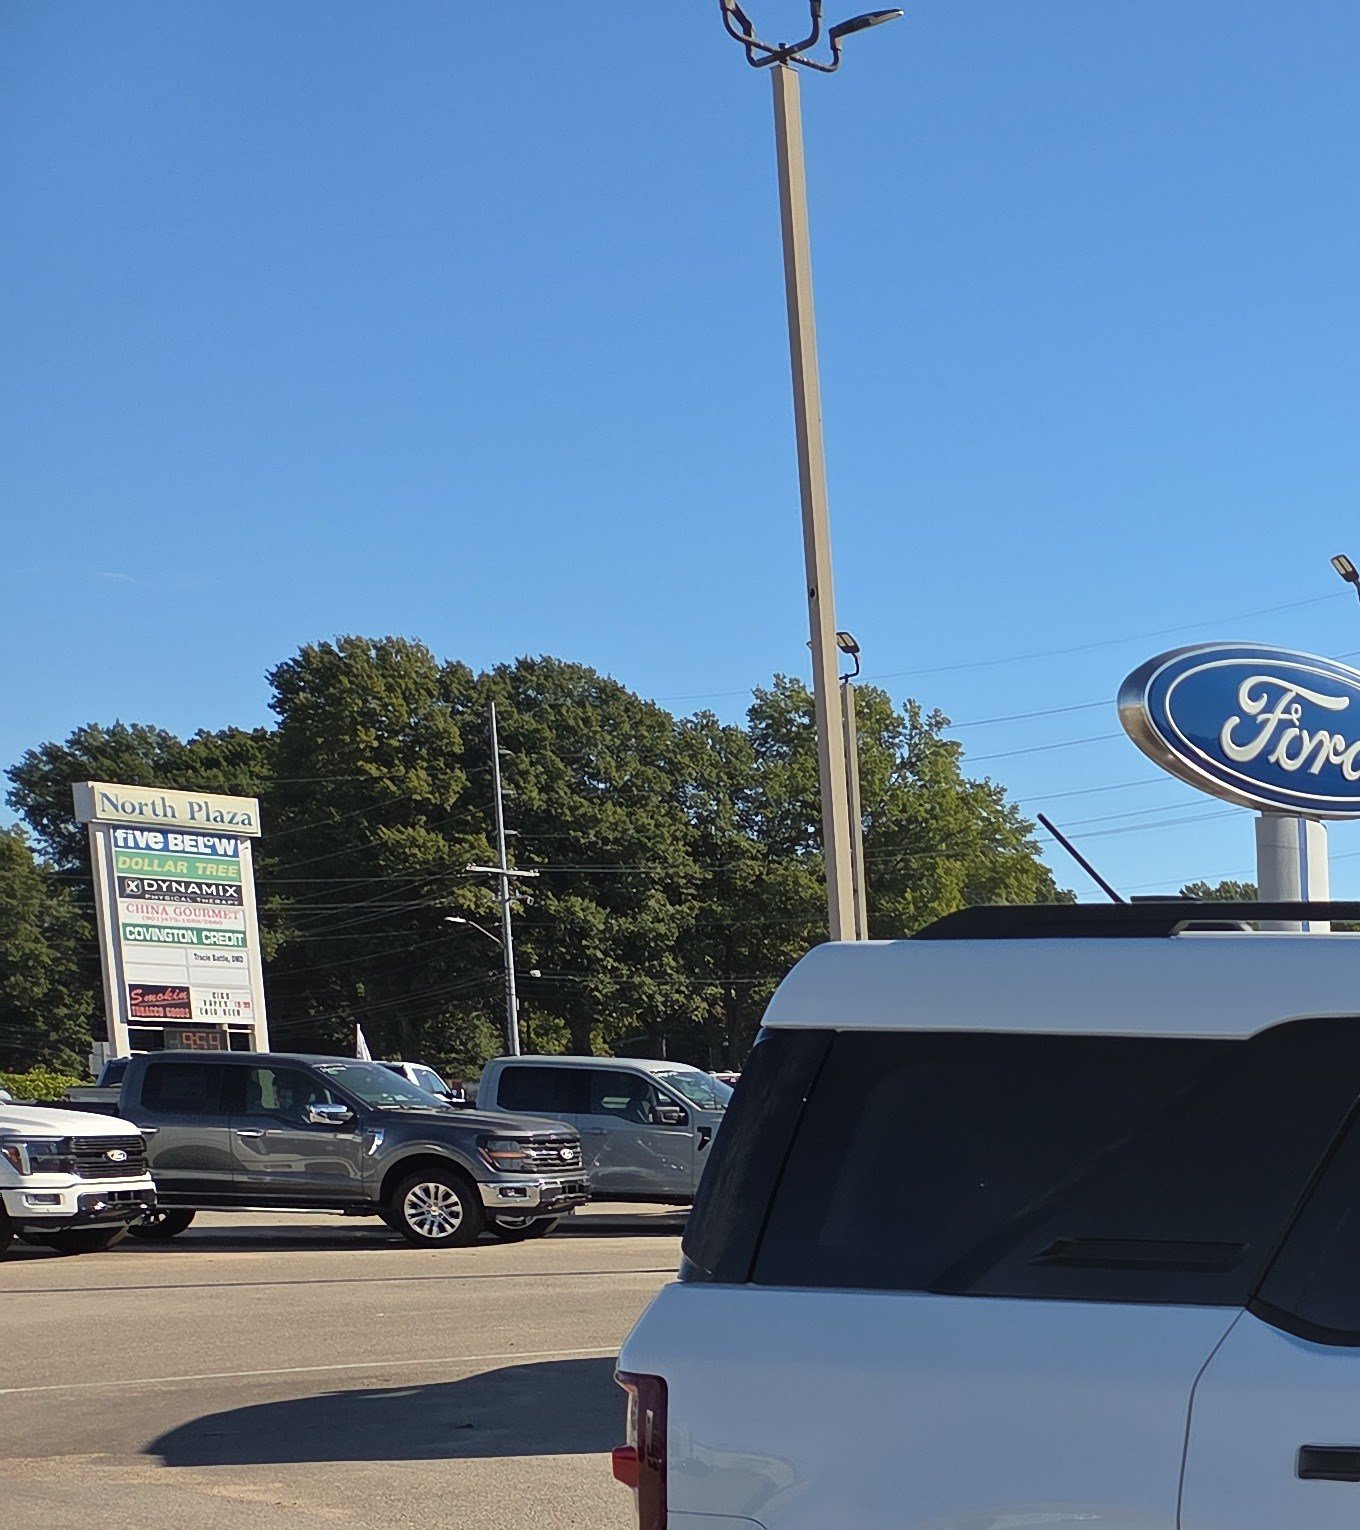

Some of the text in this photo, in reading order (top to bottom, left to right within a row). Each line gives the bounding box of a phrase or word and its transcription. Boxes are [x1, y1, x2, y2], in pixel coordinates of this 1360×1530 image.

[100, 792, 252, 827] North Plaza
[115, 830, 164, 850] five
[117, 856, 240, 878] DOLLAR TREE
[144, 880, 238, 898] DYNAMIX
[145, 894, 239, 906] PHYSICAL THERAPY
[126, 903, 169, 916] CHINA
[174, 906, 240, 920] GOURMET
[126, 926, 245, 946] COVINGTON CREDIT
[131, 987, 188, 1004] Smokin
